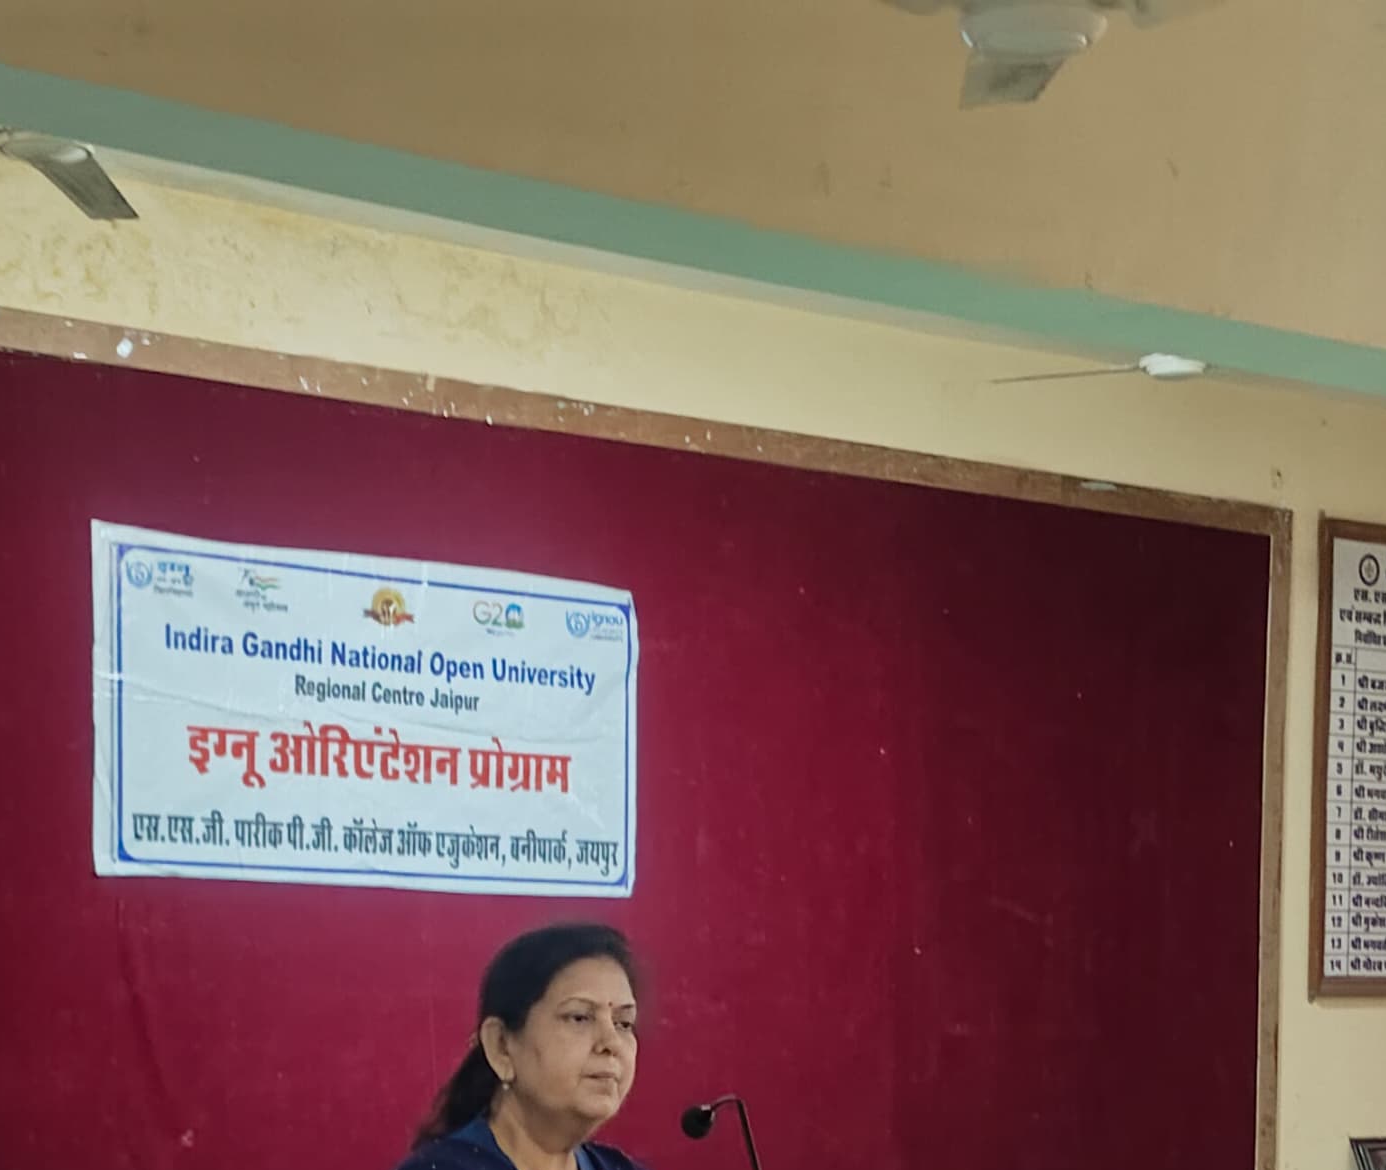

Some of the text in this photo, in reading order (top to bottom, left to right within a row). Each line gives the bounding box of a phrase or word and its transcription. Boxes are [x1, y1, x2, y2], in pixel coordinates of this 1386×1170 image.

[473, 600, 524, 629] G20
[165, 623, 596, 696] Indira Gandhi National Open University
[294, 673, 480, 715] Regional Centre Jaipur
[187, 721, 571, 792] इग्नू ओरिएंटेशन प्रोग्राम
[234, 812, 284, 849] पारीक
[343, 818, 393, 856] कॉलेज
[397, 822, 431, 857] ऑफ
[435, 825, 505, 869] एजुकेशन,
[576, 839, 619, 876] जयपुर
